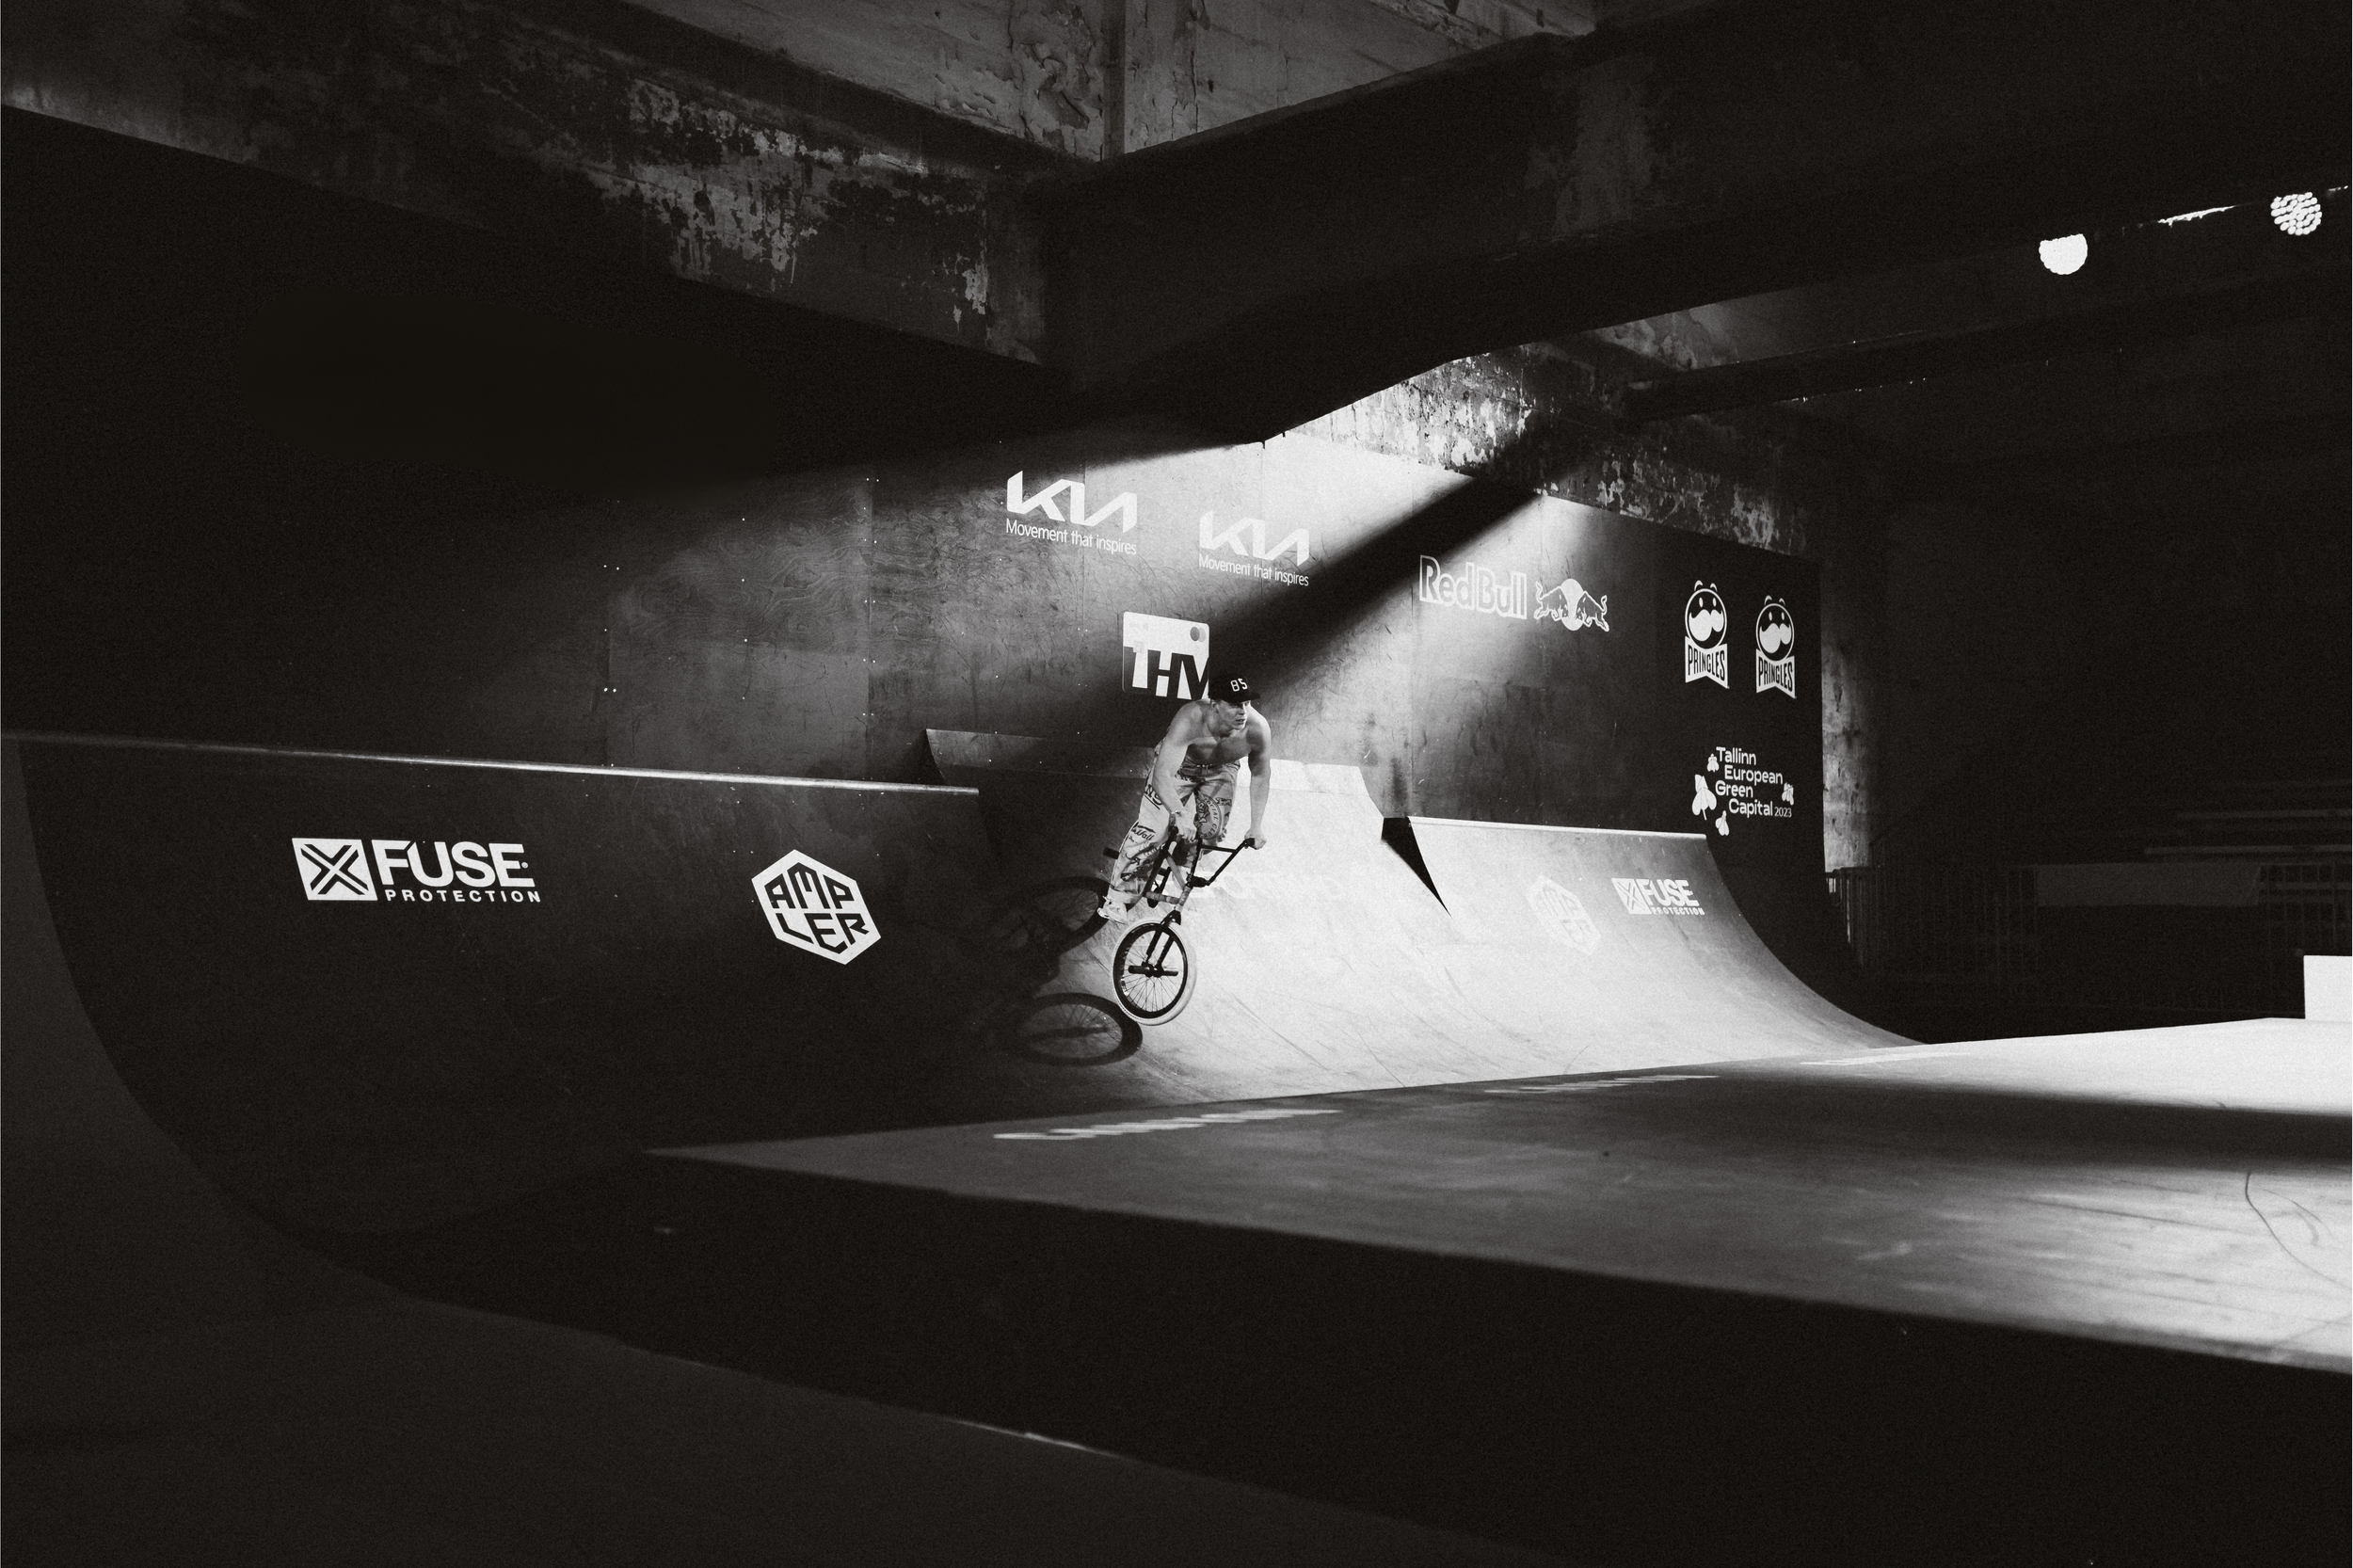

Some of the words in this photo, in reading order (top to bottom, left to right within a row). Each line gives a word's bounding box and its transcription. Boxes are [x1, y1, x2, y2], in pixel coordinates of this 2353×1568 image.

[1006, 519, 1067, 543] Movement
[1071, 531, 1093, 547] that
[1096, 535, 1137, 555] inspires
[1199, 553, 1251, 575] Movement
[1254, 564, 1273, 579] that
[1274, 568, 1309, 586] inspires
[1688, 644, 1725, 681] PRINGLES
[1758, 656, 1793, 692] PRINGLES
[1716, 746, 1756, 765] Tallinn
[1724, 764, 1783, 786] European
[1715, 779, 1753, 798] Green
[1728, 798, 1773, 818] Capital
[1774, 807, 1792, 818] 2023
[371, 840, 536, 888] FUSE
[384, 889, 541, 903] PROTECTION
[1636, 878, 1700, 906] FUSE
[1651, 906, 1705, 916] PROTECTION
